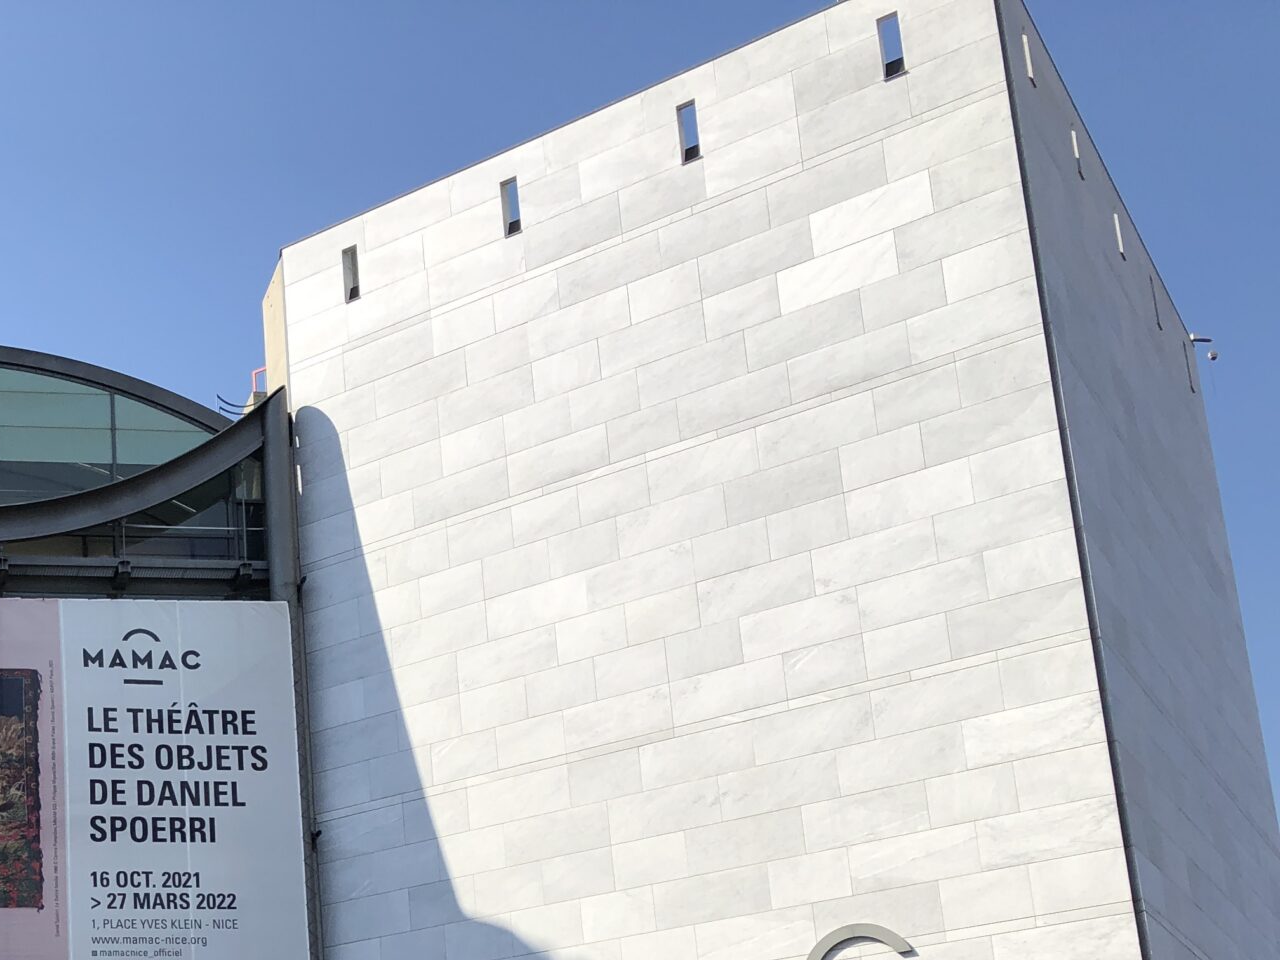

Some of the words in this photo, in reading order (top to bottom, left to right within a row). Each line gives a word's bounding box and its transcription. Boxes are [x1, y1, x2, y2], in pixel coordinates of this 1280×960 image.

[82, 648, 202, 670] MAMAC
[87, 707, 118, 733] LE
[127, 702, 257, 735] THÉÂTRE
[88, 743, 145, 769] DES
[155, 744, 268, 771] OBJETS
[89, 779, 127, 805] DE
[137, 780, 246, 807] DANIEL
[89, 816, 216, 843] SPOERRI
[90, 871, 110, 888] 16
[116, 871, 156, 888] OCT.
[161, 871, 201, 888] 2021
[107, 893, 127, 910] 27
[133, 893, 191, 910] MARS
[196, 893, 237, 910] 2022
[103, 919, 137, 930] PLACE
[140, 919, 168, 930] YVES
[170, 919, 202, 930] KLEIN
[212, 919, 239, 930] NICE
[91, 935, 208, 947] www.mamac-nice.org
